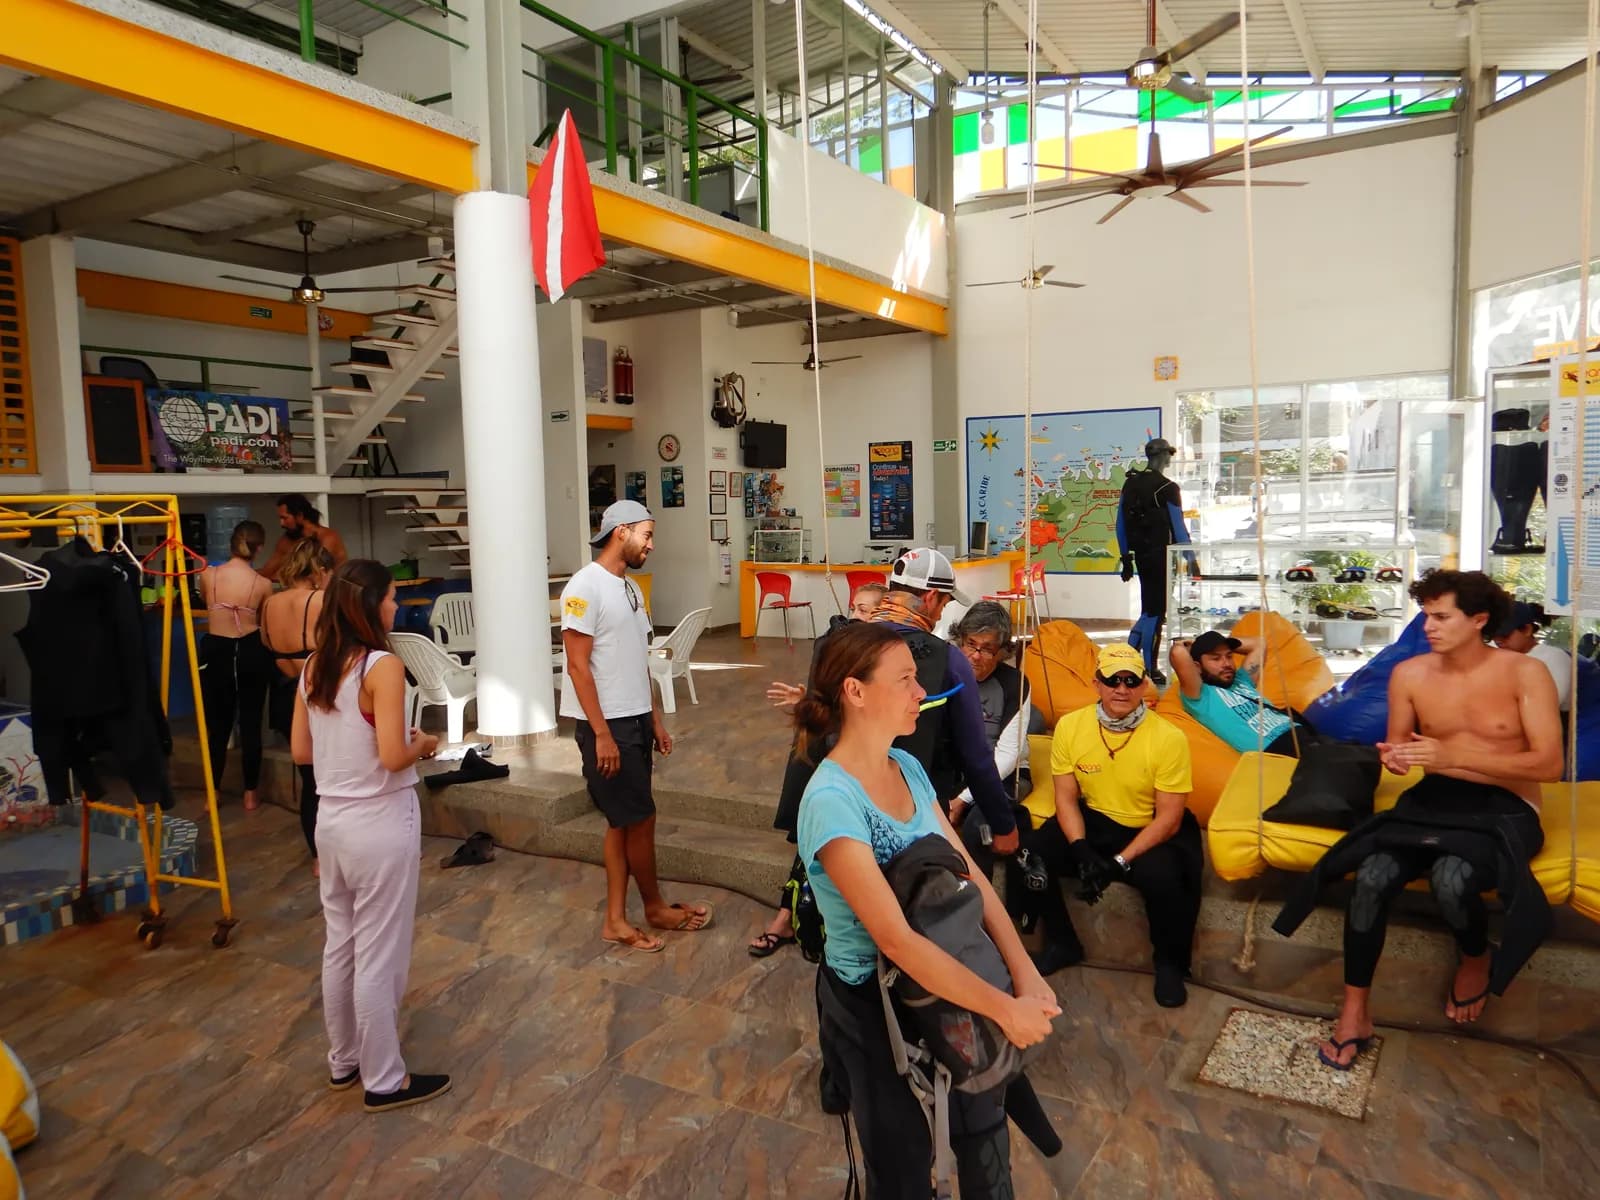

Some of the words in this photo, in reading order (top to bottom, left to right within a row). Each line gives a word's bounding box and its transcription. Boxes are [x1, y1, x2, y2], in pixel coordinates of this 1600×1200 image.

[207, 402, 278, 435] PADI
[211, 435, 278, 448] padi.com
[164, 454, 177, 463] The
[180, 455, 197, 465] Way
[214, 456, 235, 465] World
[978, 474, 991, 507] CARIBE
